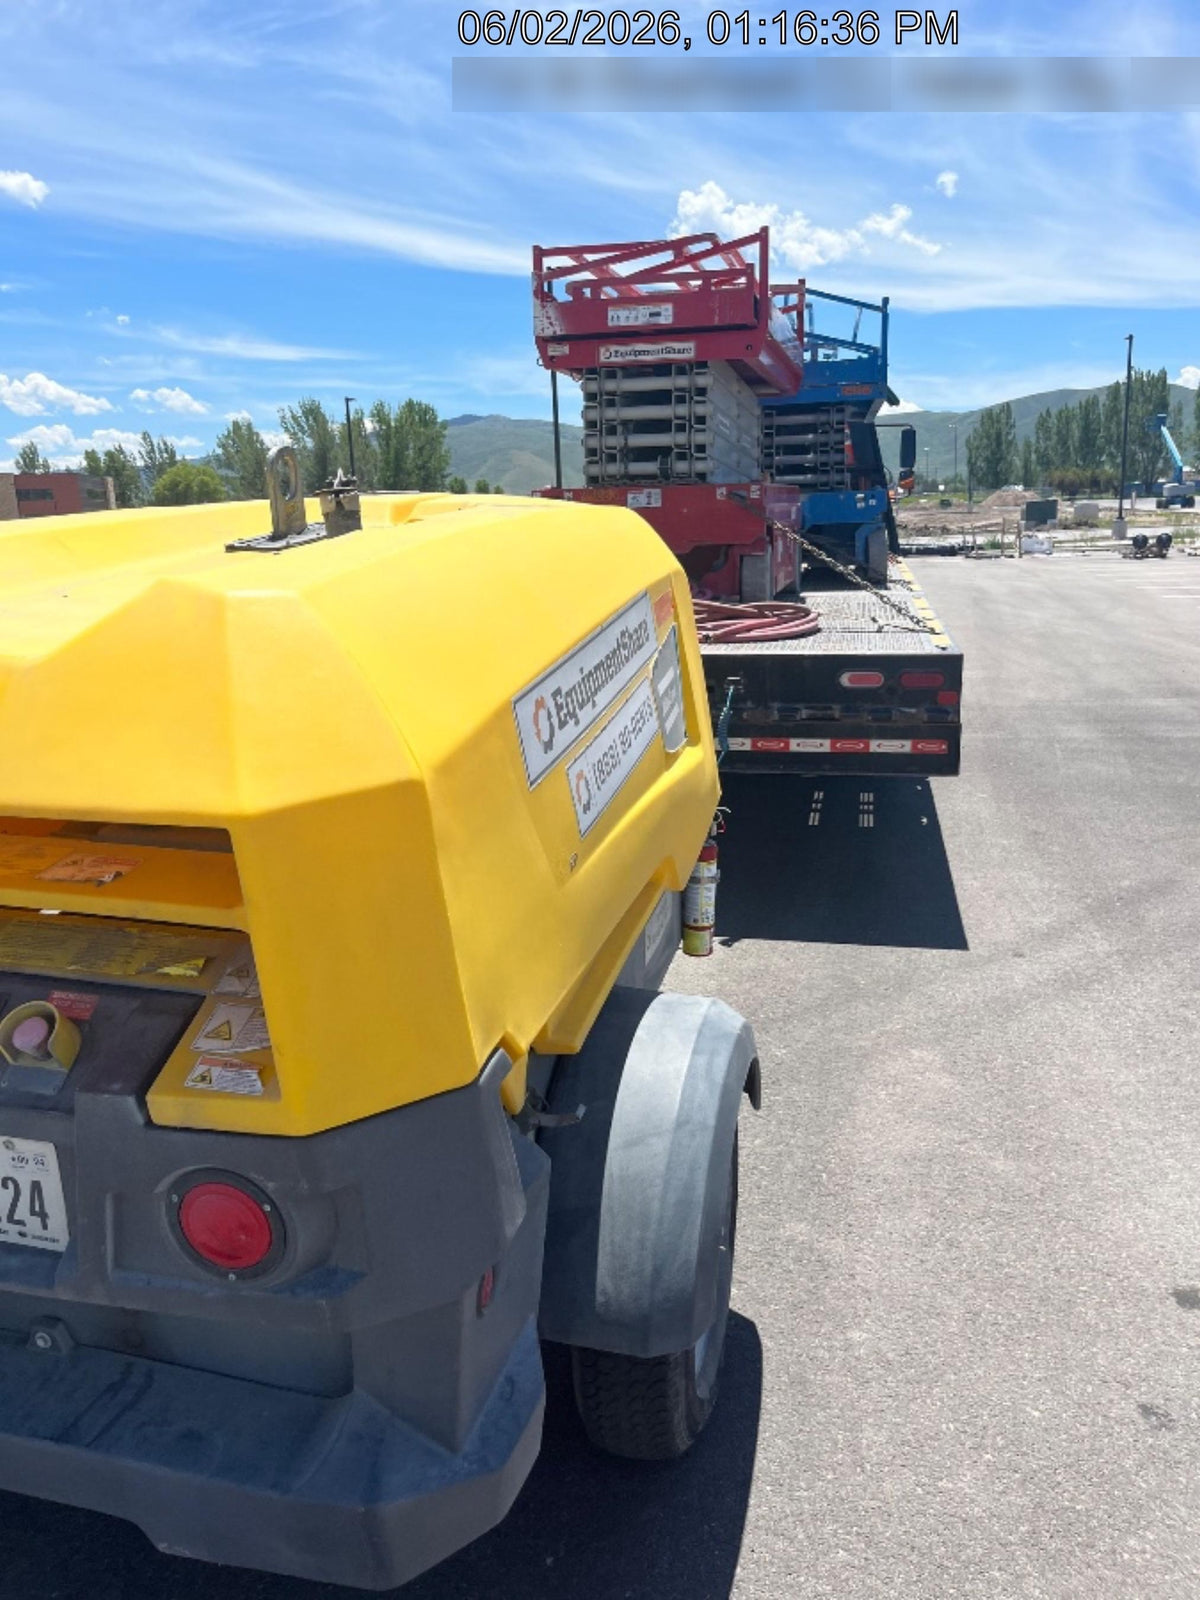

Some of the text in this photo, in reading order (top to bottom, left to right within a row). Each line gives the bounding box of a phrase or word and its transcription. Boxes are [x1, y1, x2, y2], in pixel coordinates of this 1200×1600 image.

[613, 345, 693, 359] EquipmentShare
[550, 618, 650, 731] EquipmentShare
[0, 1176, 50, 1232] 24
